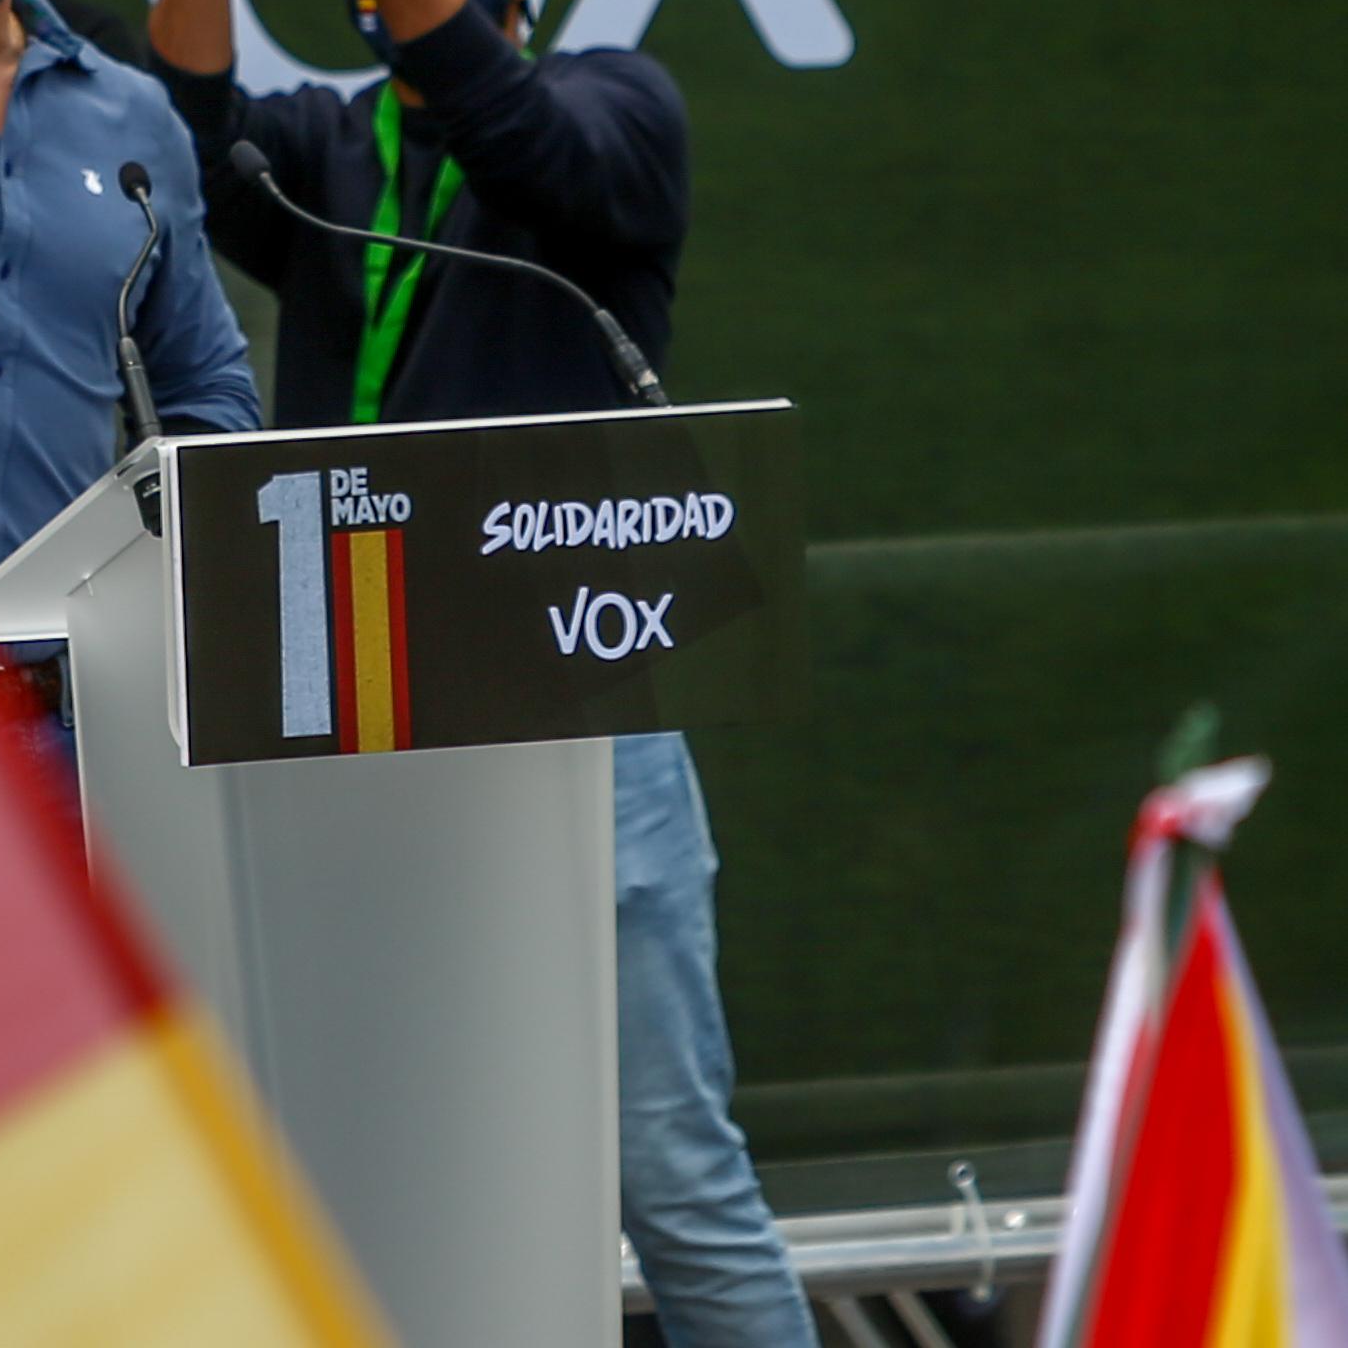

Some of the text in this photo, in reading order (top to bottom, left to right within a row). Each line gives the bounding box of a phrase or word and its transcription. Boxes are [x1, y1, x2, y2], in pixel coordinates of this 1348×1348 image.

[329, 467, 369, 498] DE
[330, 492, 411, 527] MAYO
[480, 491, 735, 556] SOLIDARIDAD
[257, 470, 332, 739] 1
[548, 586, 674, 661] VOX
